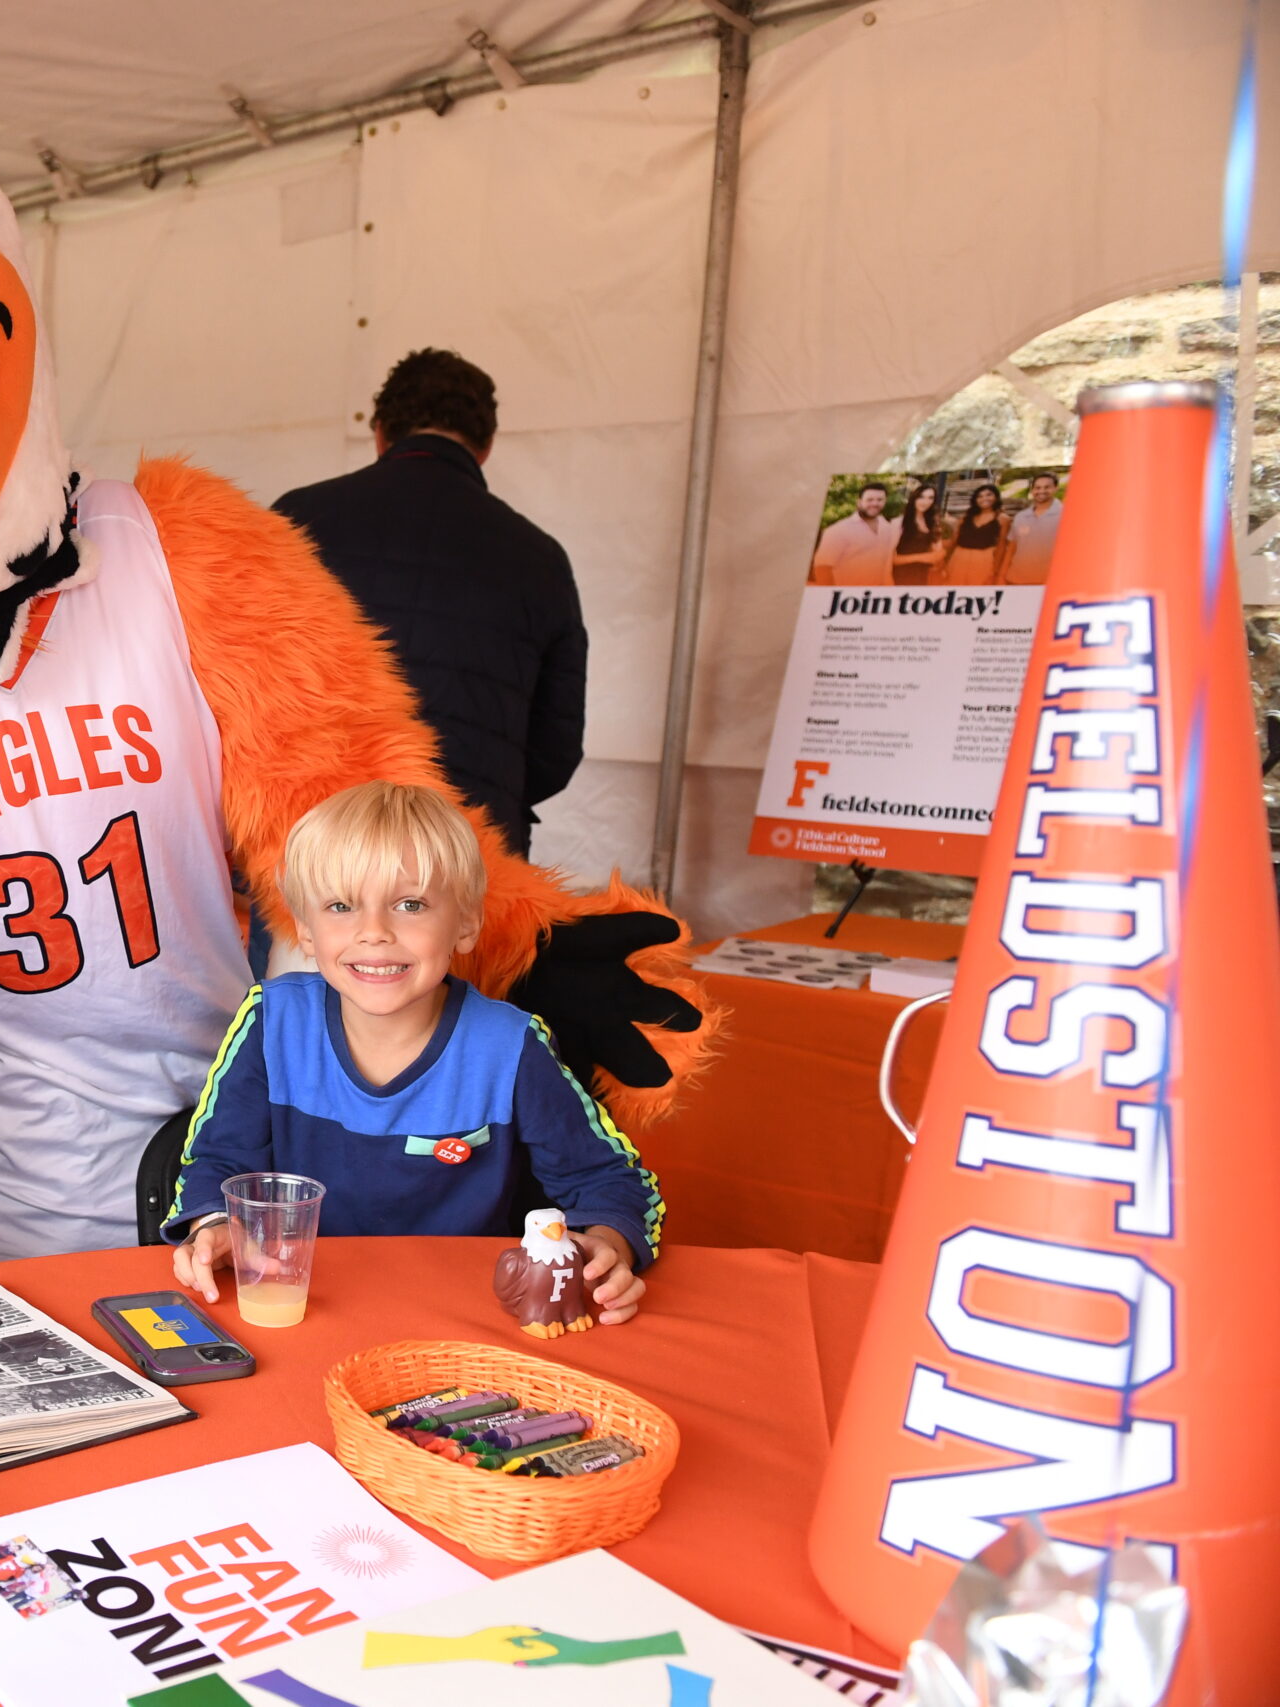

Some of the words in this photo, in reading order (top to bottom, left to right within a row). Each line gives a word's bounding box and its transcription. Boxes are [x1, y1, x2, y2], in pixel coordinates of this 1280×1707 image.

[821, 590, 892, 620] Join
[899, 590, 1004, 621] today!
[826, 625, 863, 633] Connect
[816, 670, 836, 679] Give
[838, 671, 859, 679] back
[806, 717, 840, 726] Expand
[786, 760, 830, 807] F
[796, 828, 837, 842] Ethical
[837, 831, 881, 846] Culture
[794, 840, 847, 855] Fieldston
[847, 846, 887, 858] School
[879, 596, 1179, 1586] FIELDSTON
[447, 1141, 456, 1150] I
[437, 1148, 463, 1164] ECFS
[549, 1268, 574, 1303] F
[581, 1453, 621, 1473] CRAYONS
[193, 1522, 360, 1638] FAN
[129, 1539, 294, 1660] FUN
